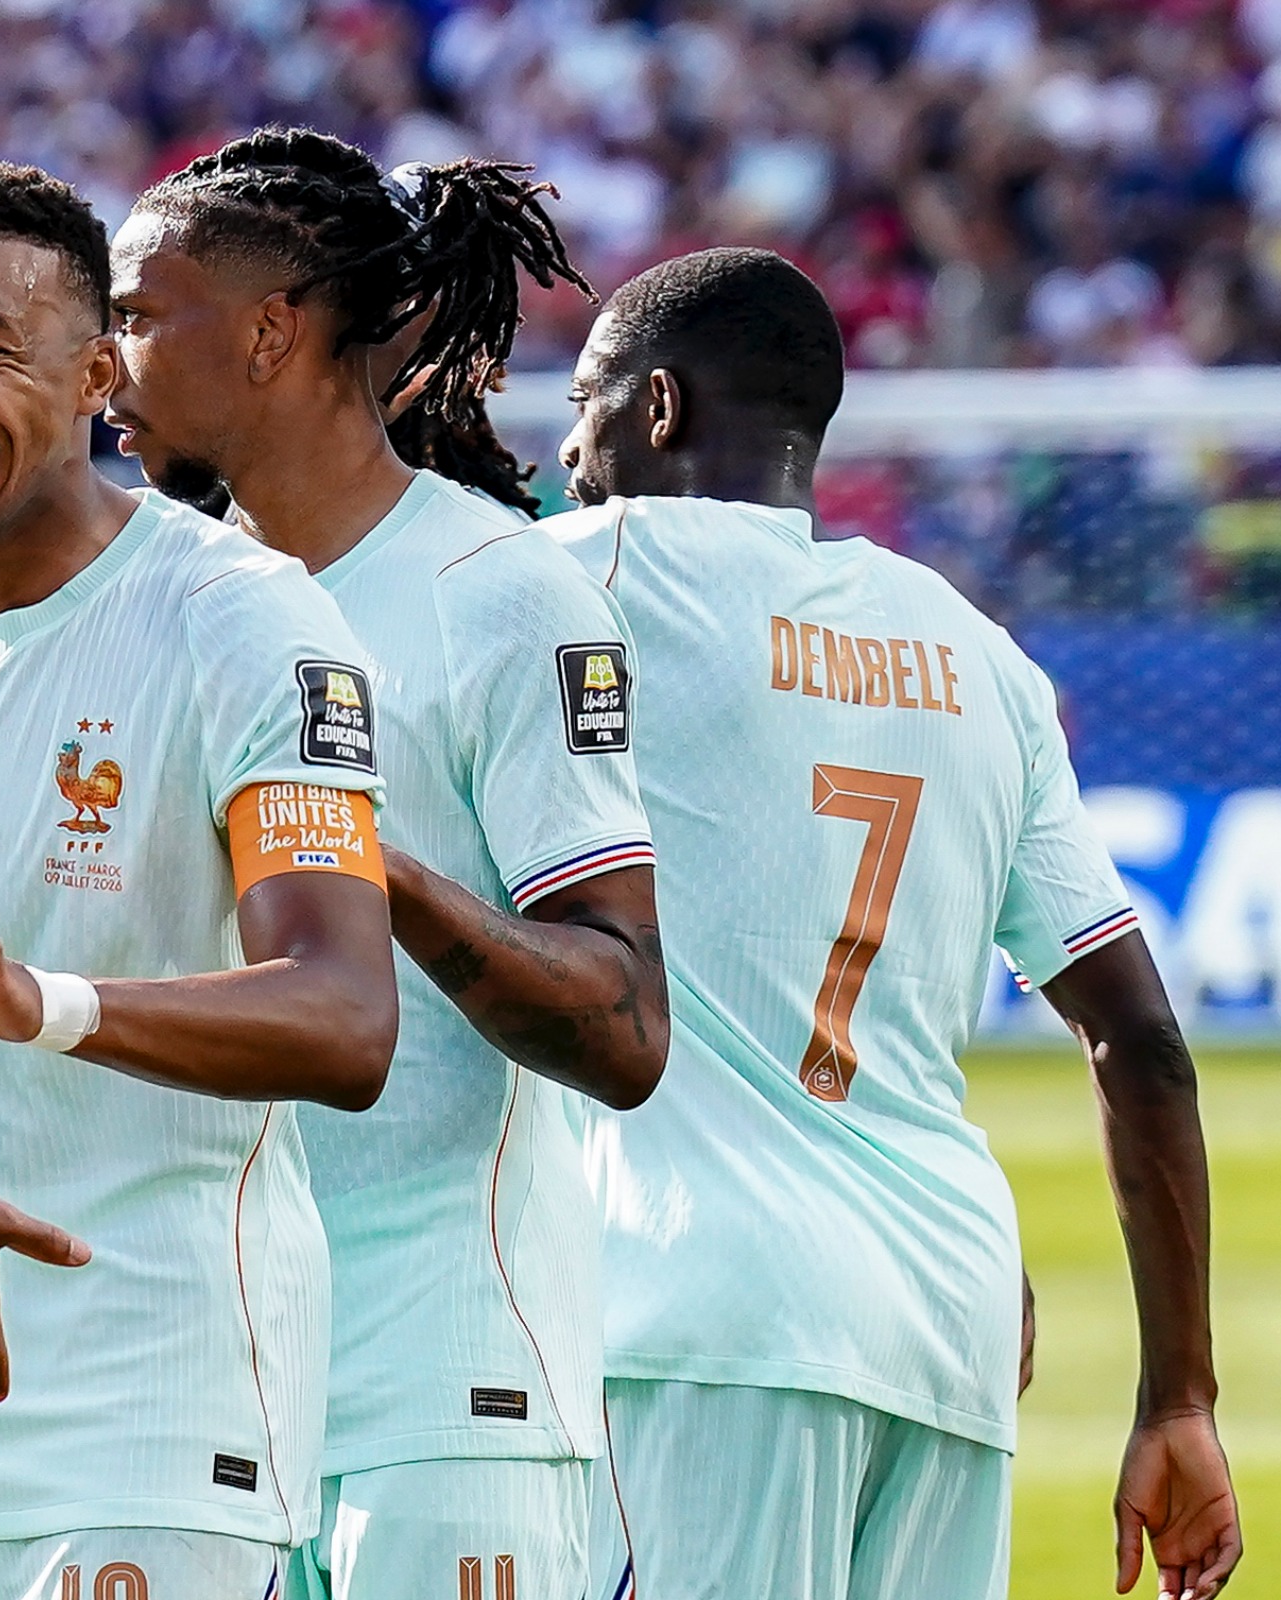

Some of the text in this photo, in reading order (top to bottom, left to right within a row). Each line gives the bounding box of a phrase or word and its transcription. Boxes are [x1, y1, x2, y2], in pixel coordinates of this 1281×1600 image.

[770, 615, 963, 716] DEMBELE
[316, 723, 371, 752] EDUCATION
[335, 745, 358, 759] FIFA
[258, 783, 352, 807] FOOTBALL
[259, 800, 356, 831] UNITES
[256, 827, 364, 857] the World
[45, 857, 77, 873] FRANCE
[86, 863, 122, 878] MAROC
[297, 854, 336, 865] FIFA
[44, 871, 60, 885] 09
[93, 876, 123, 892] 2026
[798, 763, 925, 1102] 7
